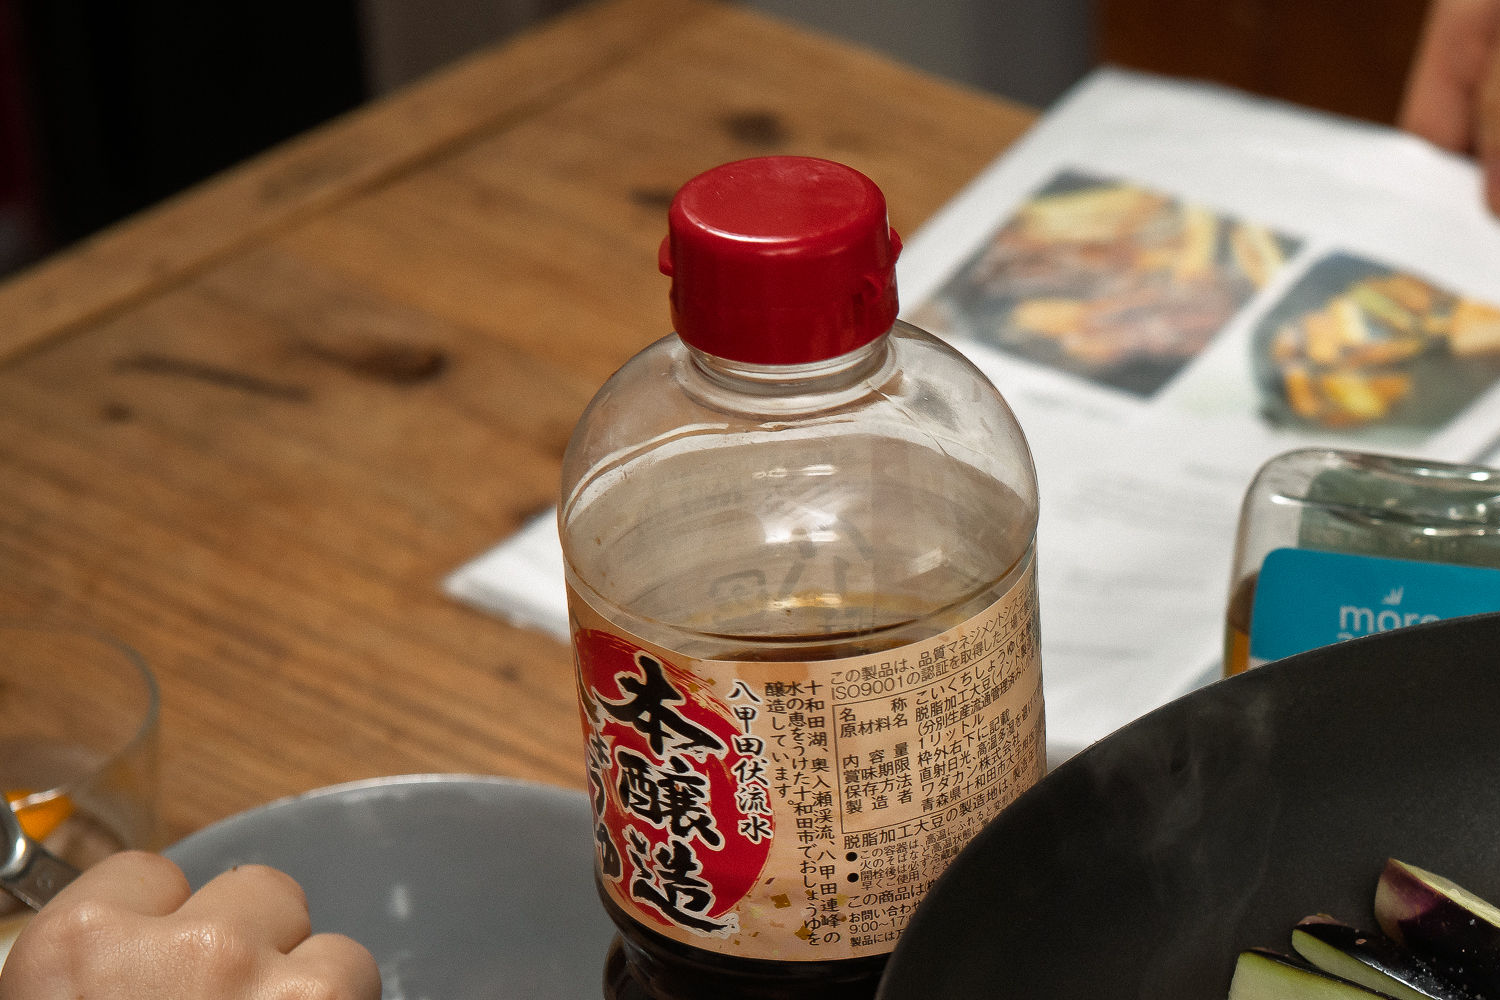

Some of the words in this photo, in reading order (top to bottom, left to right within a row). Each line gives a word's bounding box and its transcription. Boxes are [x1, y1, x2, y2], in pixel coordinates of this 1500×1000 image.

[765, 681, 796, 806] 醸造しています。
[839, 714, 908, 738] 原材料名
[840, 697, 908, 722] 名称
[842, 742, 908, 768] 内容量
[918, 713, 984, 748] 1リットル
[844, 758, 911, 784] 賞味期限
[918, 708, 1010, 766] 枠外右下に記載
[592, 653, 737, 934] 本醸造
[729, 681, 772, 842] 八甲田伏流水
[845, 774, 912, 799] 保存方法
[846, 791, 912, 814] 製造者
[921, 730, 1020, 798] ワダカン株式会社
[784, 681, 821, 946] 水の恵をうけた十和田市でおしょうゆを
[804, 681, 841, 944] 十和田湖、奥入瀬渓流、八甲田連峰の
